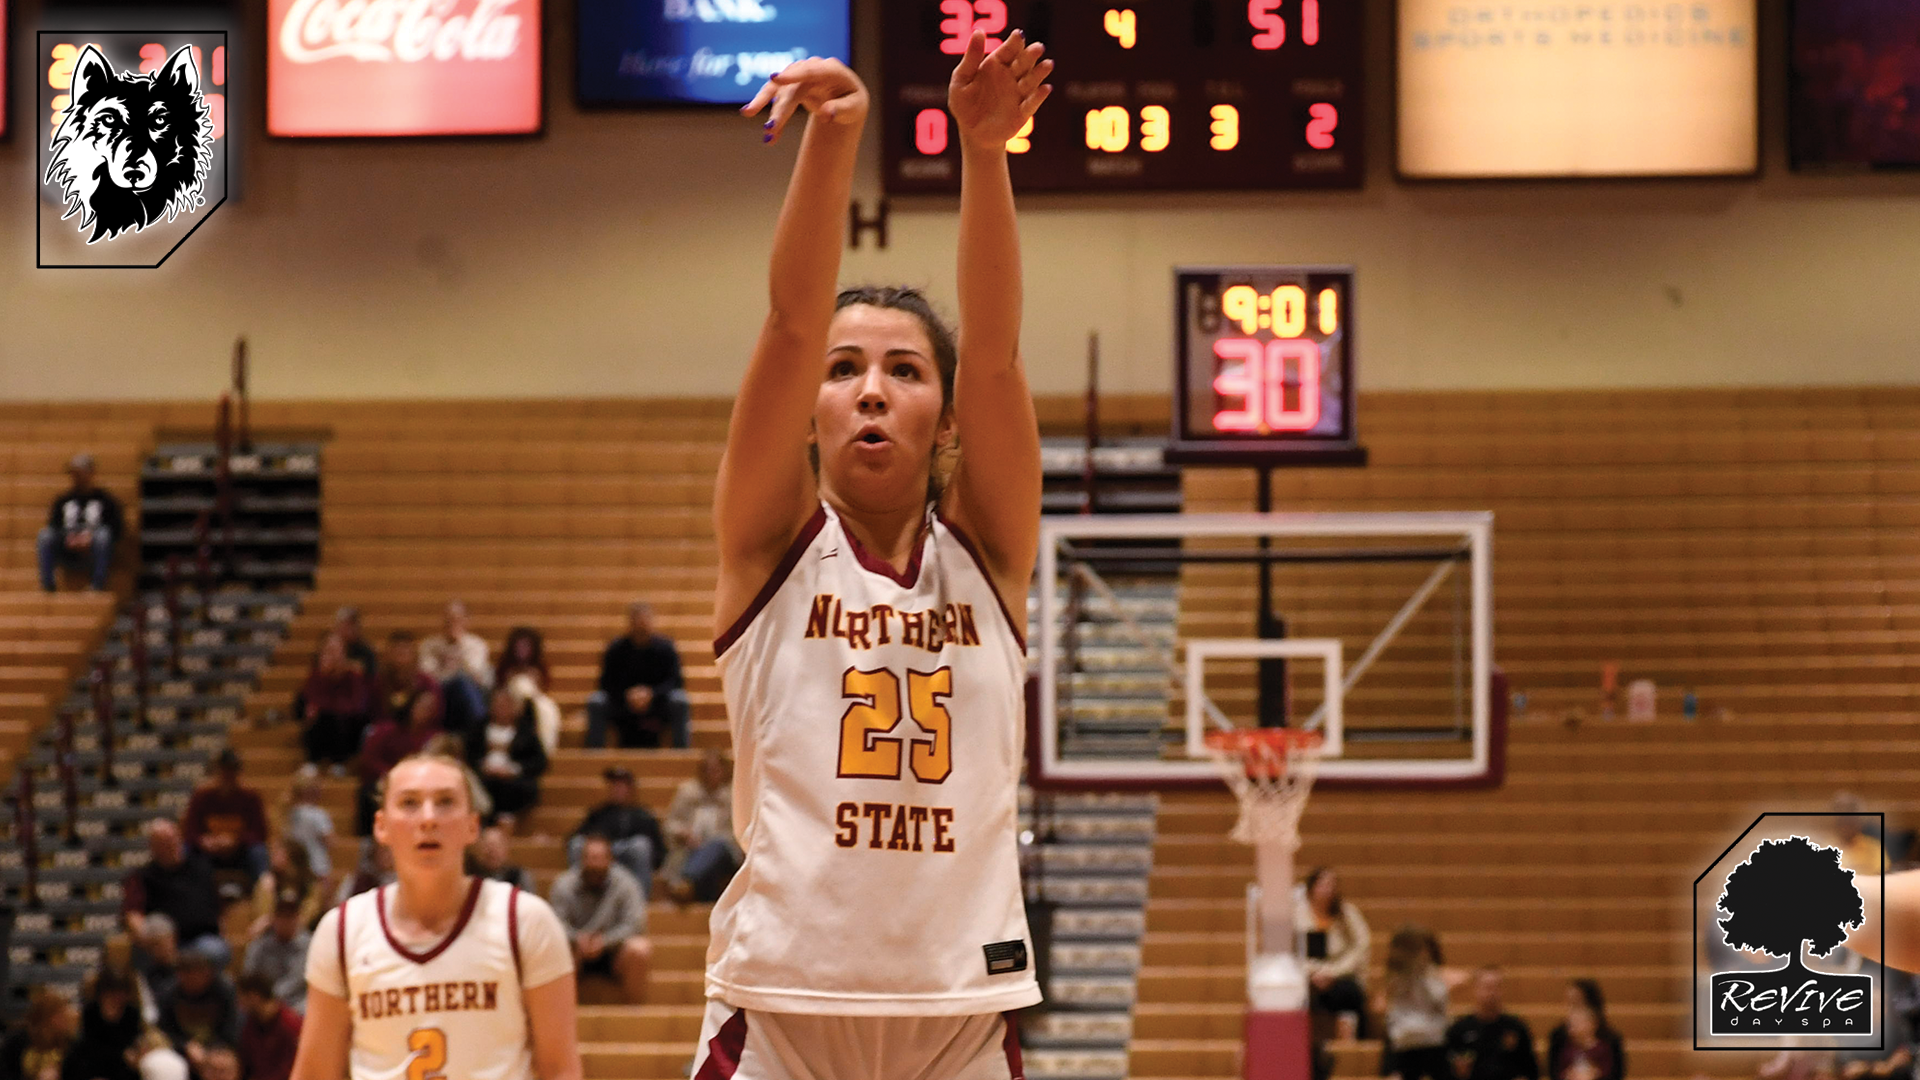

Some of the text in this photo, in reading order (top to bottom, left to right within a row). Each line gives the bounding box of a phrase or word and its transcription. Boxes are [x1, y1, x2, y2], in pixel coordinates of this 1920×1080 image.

[939, 0, 1008, 54] 32
[1104, 8, 1136, 49] 4
[1248, 0, 1319, 50] 51
[915, 108, 948, 155] 0
[1085, 105, 1130, 153] 10
[1140, 104, 1170, 152] 3
[1209, 103, 1239, 151] 3
[1305, 102, 1338, 150] 2
[1222, 284, 1338, 338] 9:01
[1212, 338, 1321, 431] 30
[836, 665, 954, 784] 25
[835, 801, 955, 853] STATE
[358, 981, 499, 1019] NORTHERN
[405, 1027, 447, 1080] 2
